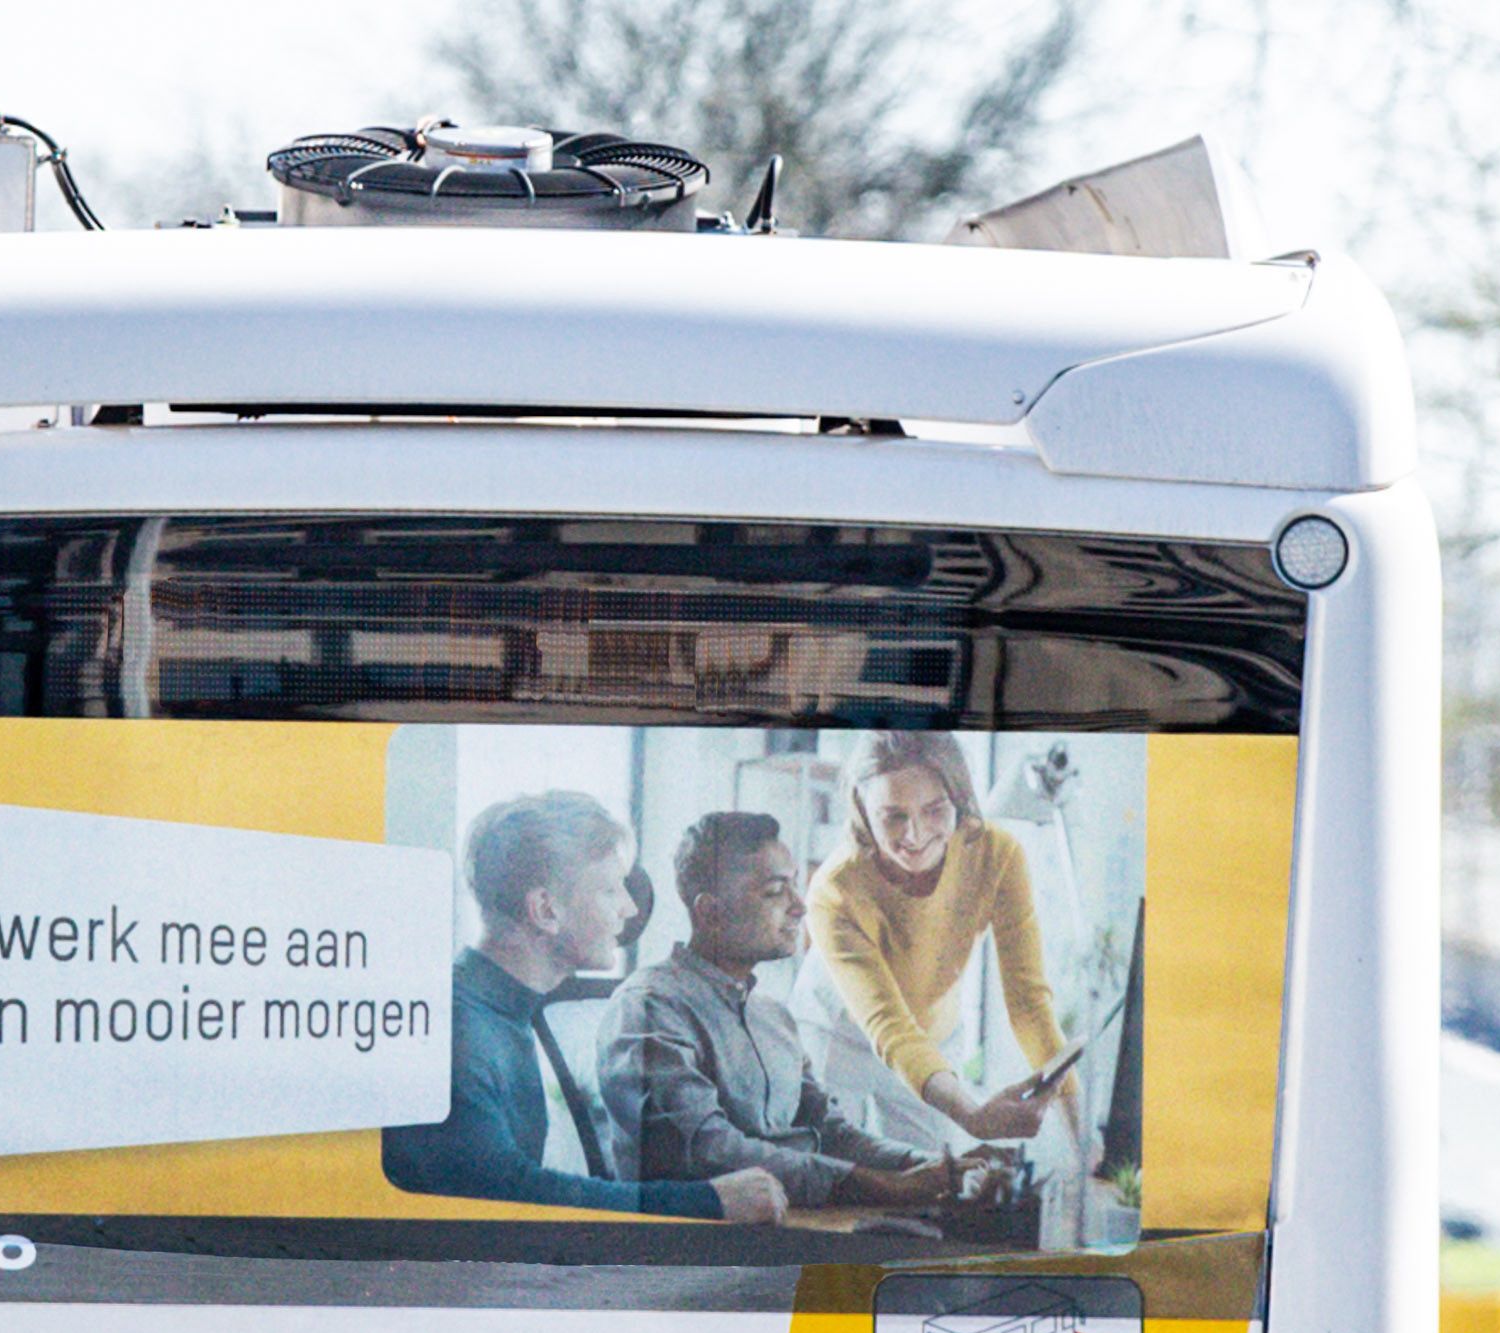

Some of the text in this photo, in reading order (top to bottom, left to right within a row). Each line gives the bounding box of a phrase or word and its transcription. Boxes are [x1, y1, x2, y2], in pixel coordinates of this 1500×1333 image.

[160, 919, 267, 967] mee
[284, 927, 368, 968] aan
[54, 985, 246, 1042] mooier
[263, 998, 431, 1053] morgen
